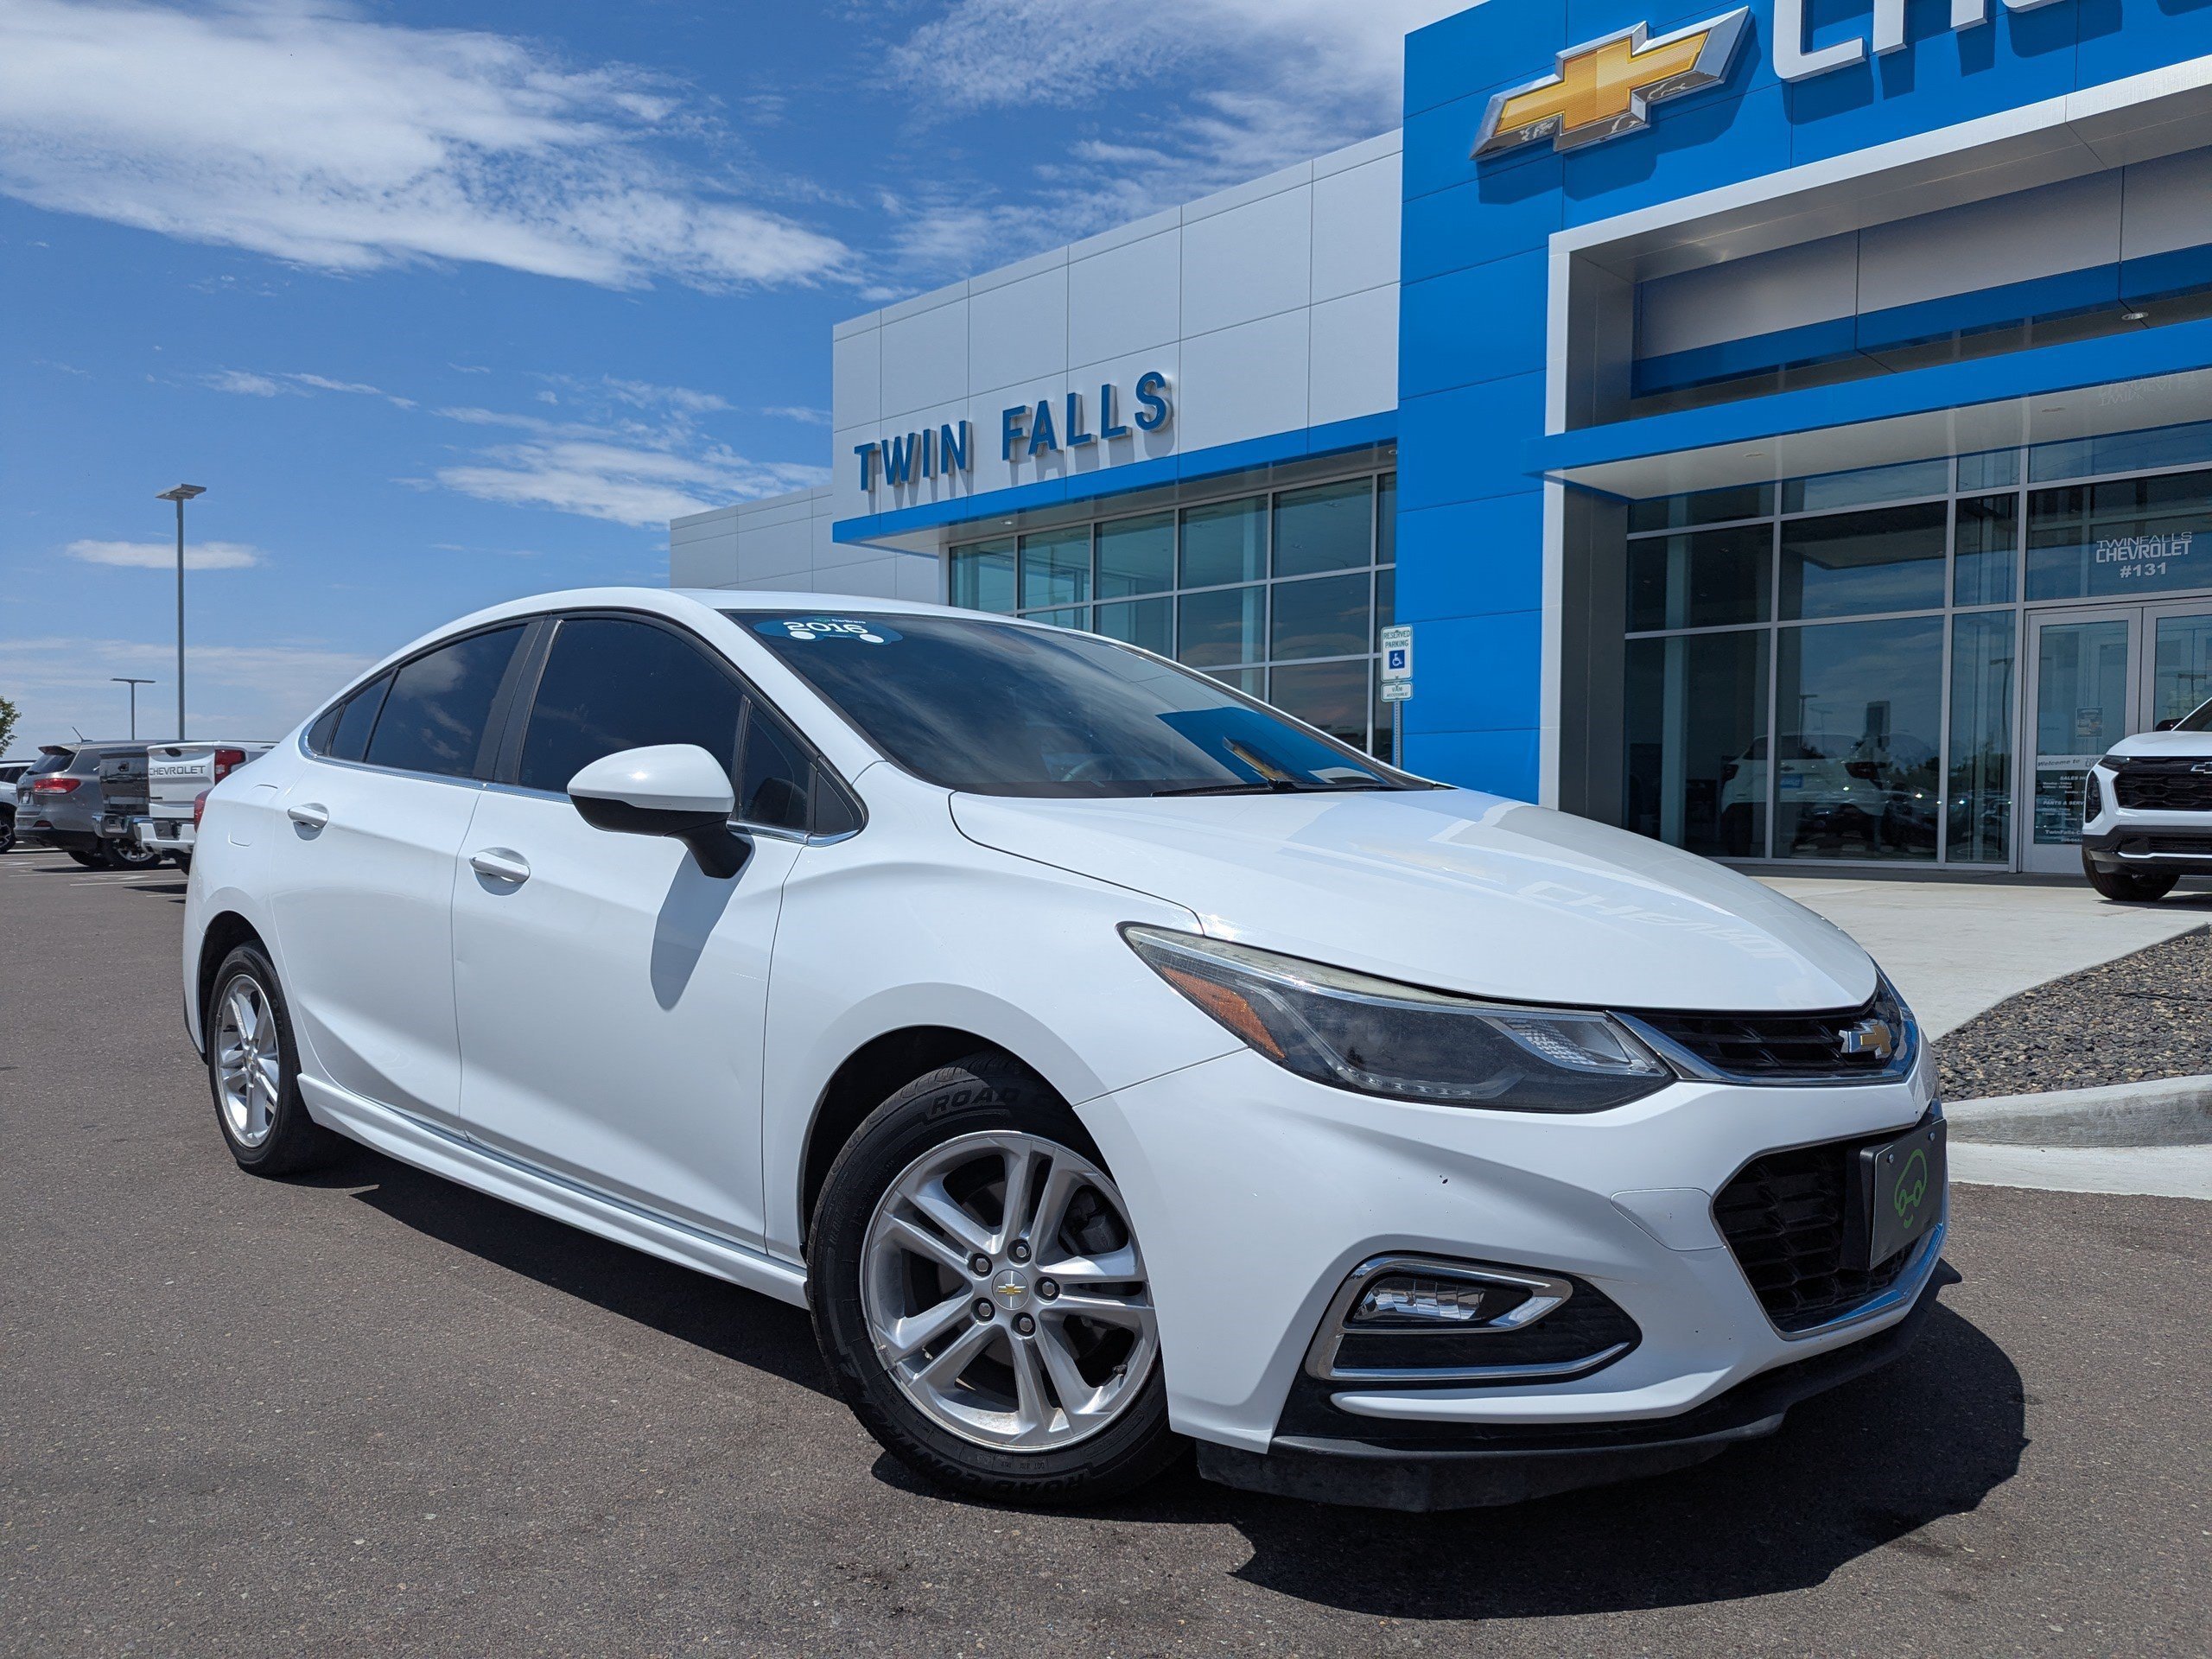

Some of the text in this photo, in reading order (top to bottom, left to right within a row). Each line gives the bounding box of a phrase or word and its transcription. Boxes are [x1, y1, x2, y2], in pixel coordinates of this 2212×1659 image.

[854, 371, 1172, 492] TWIN FALLS
[2096, 540, 2192, 563] CHEVROLET
[2120, 563, 2166, 578] #131
[783, 621, 868, 633] 2016
[1383, 630, 1410, 639] RESERVED
[149, 766, 206, 776] CHEVROLET
[931, 1086, 1020, 1116] ROAD
